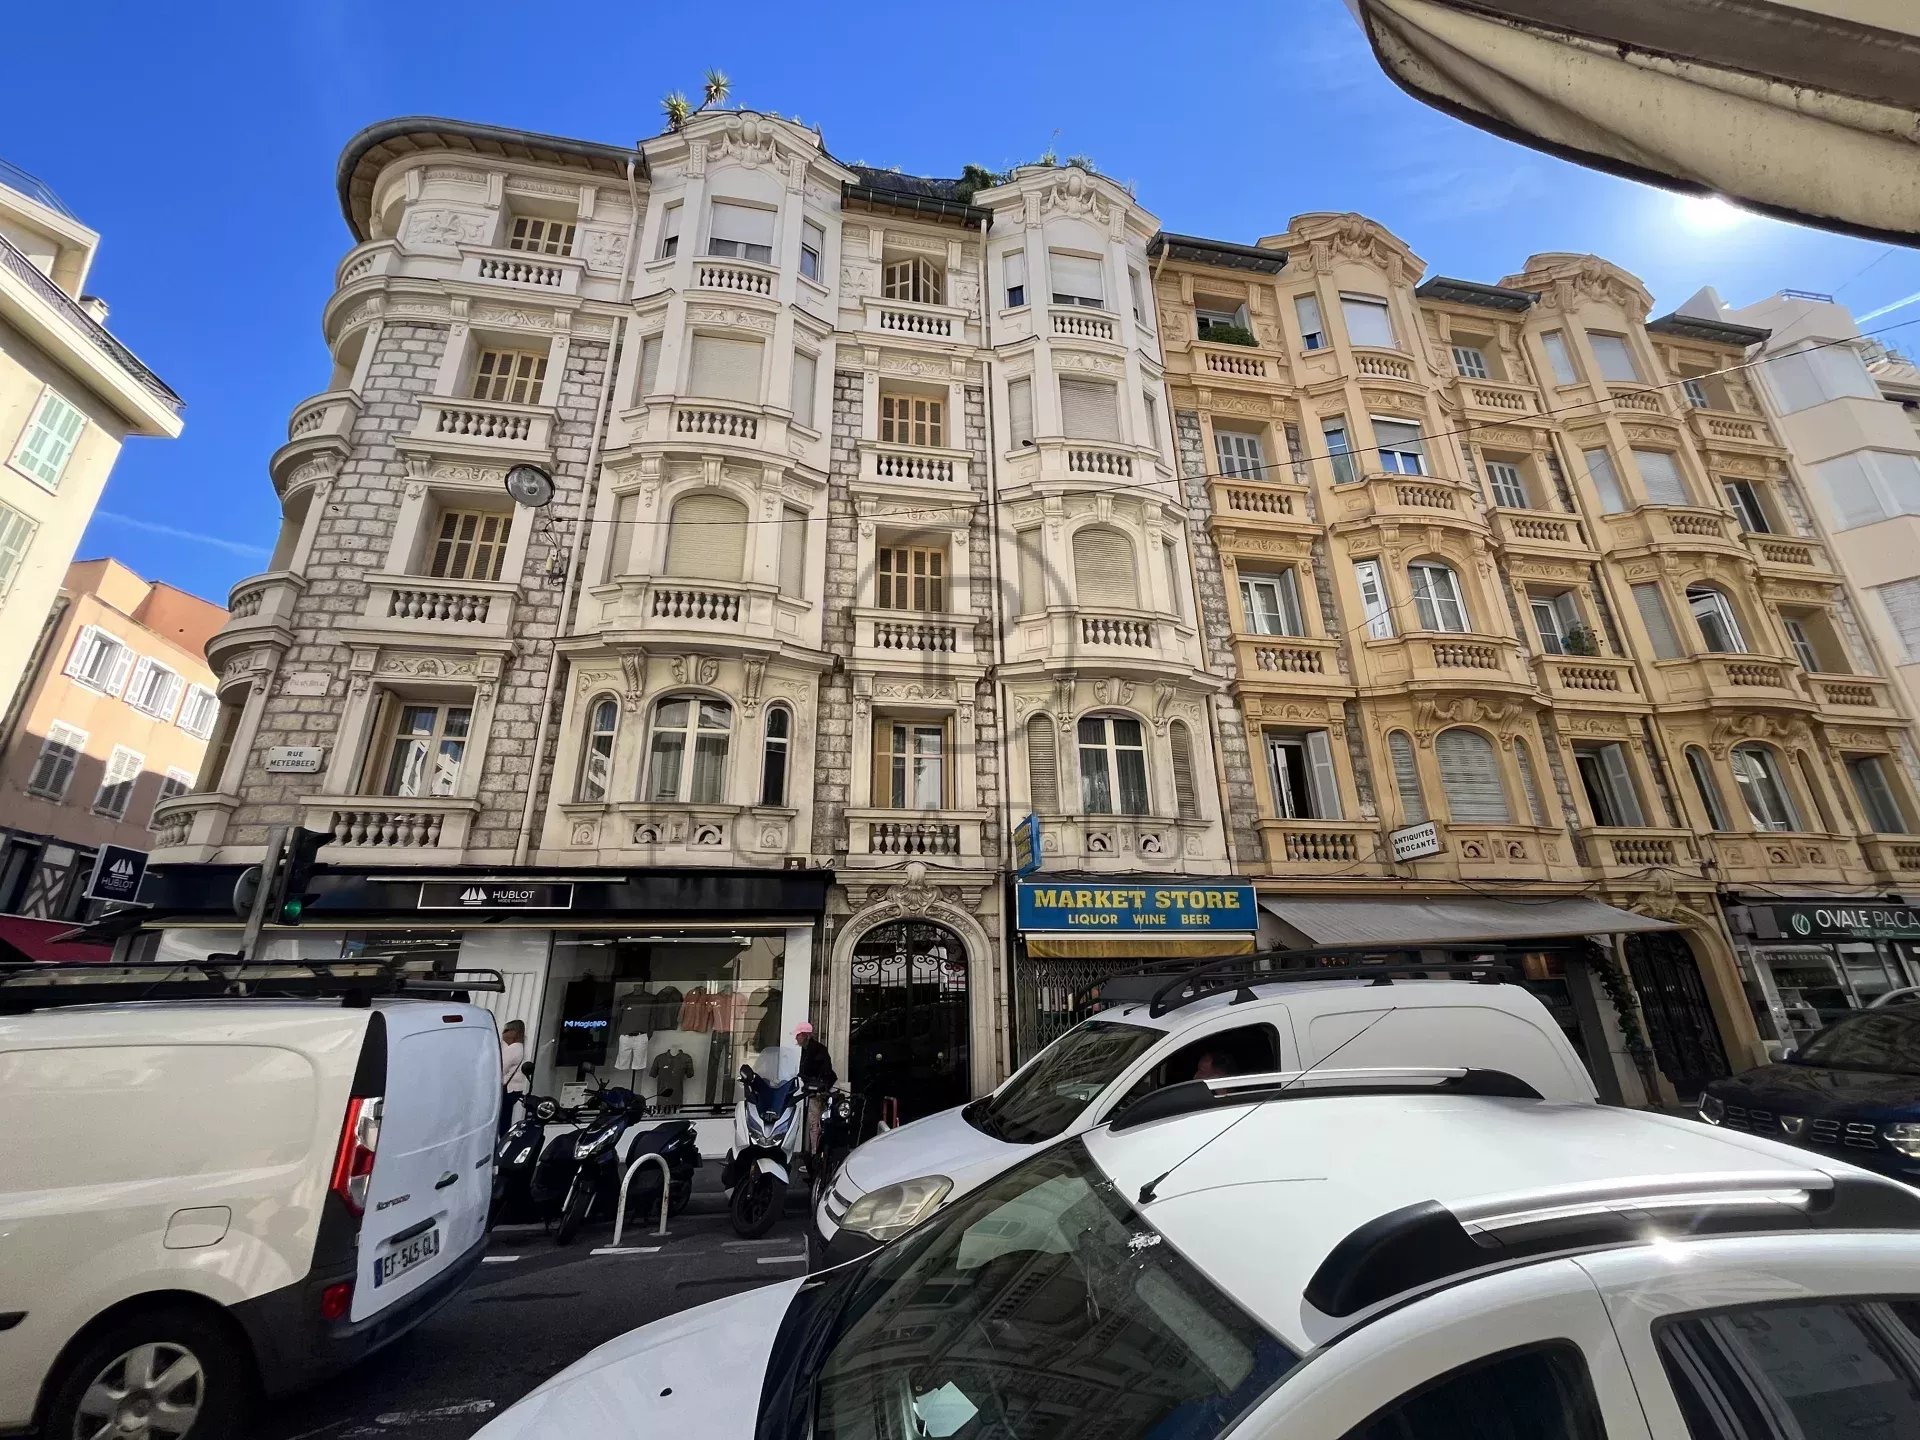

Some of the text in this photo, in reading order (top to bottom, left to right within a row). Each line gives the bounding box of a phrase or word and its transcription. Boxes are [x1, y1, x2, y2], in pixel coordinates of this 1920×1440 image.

[1394, 828, 1434, 845] ANTIQUITÉS
[1395, 838, 1437, 855] BROCANTE
[101, 876, 134, 889] HUBLOT
[492, 890, 535, 899] HUBLOT
[1034, 889, 1240, 909] MARKET STORE
[1068, 914, 1211, 926] LIQUOR WINE BEER
[1815, 909, 1871, 928] OVALE
